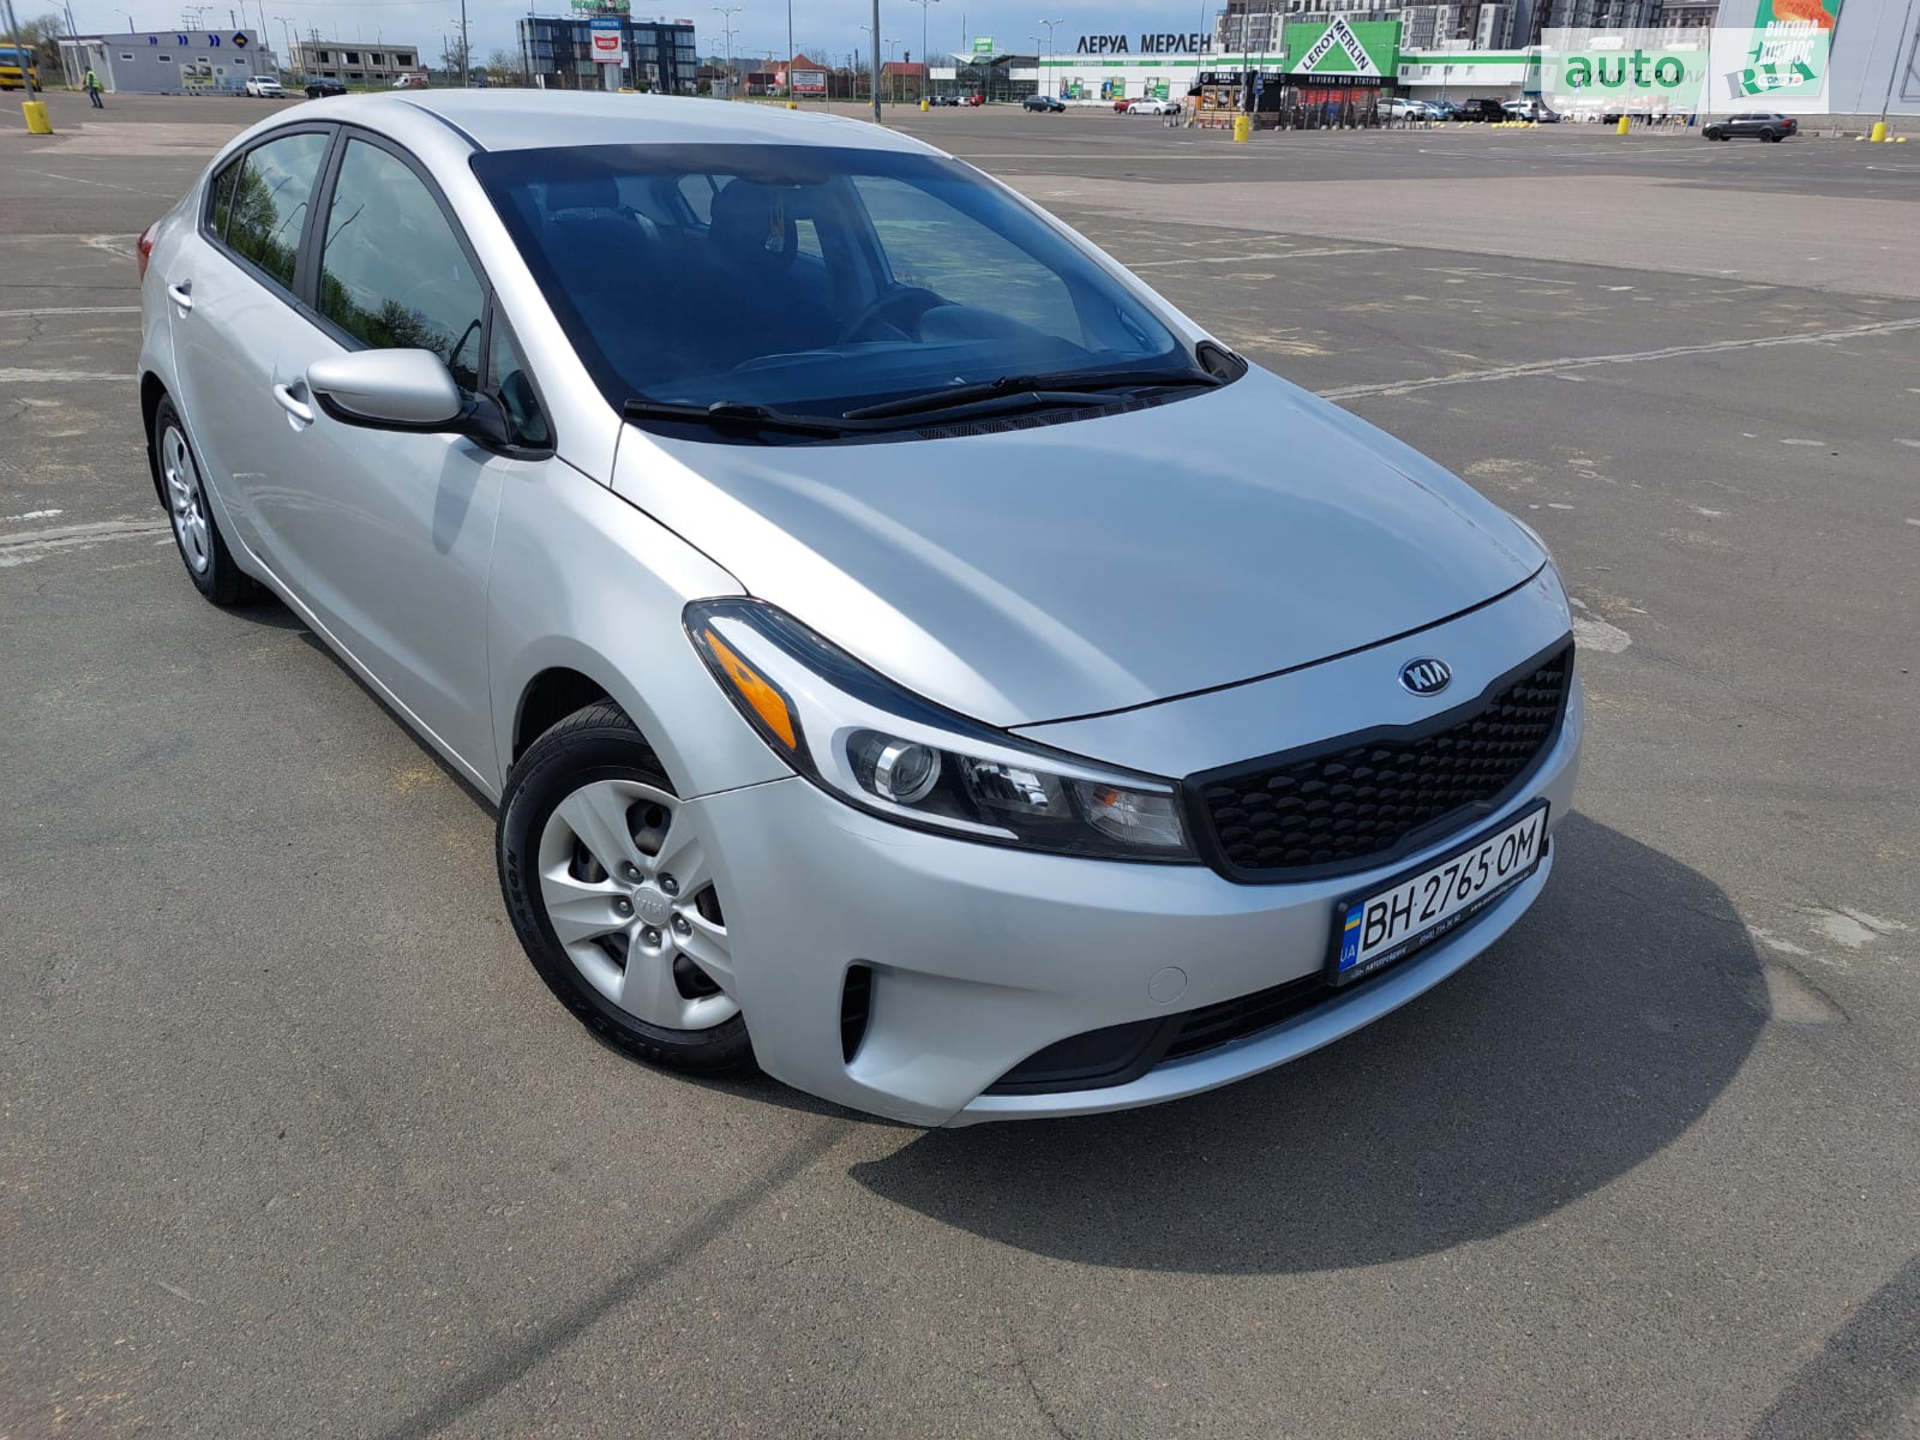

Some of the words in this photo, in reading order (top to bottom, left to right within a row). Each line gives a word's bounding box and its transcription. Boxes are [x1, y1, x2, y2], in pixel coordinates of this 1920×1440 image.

[1765, 19, 1819, 38] ВИГОДА
[1077, 35, 1128, 53] ЛЕРУА
[1141, 34, 1211, 53] МЕРЛЕН
[1303, 29, 1335, 70] LEROY
[1333, 20, 1369, 71] MERLIN
[1339, 76, 1352, 85] BUS
[1354, 76, 1381, 86] STATION
[1405, 660, 1449, 690] KIA
[1362, 886, 1415, 951] BH
[1419, 846, 1492, 922] 2765
[1497, 818, 1537, 876] OM
[1340, 944, 1356, 962] UA
